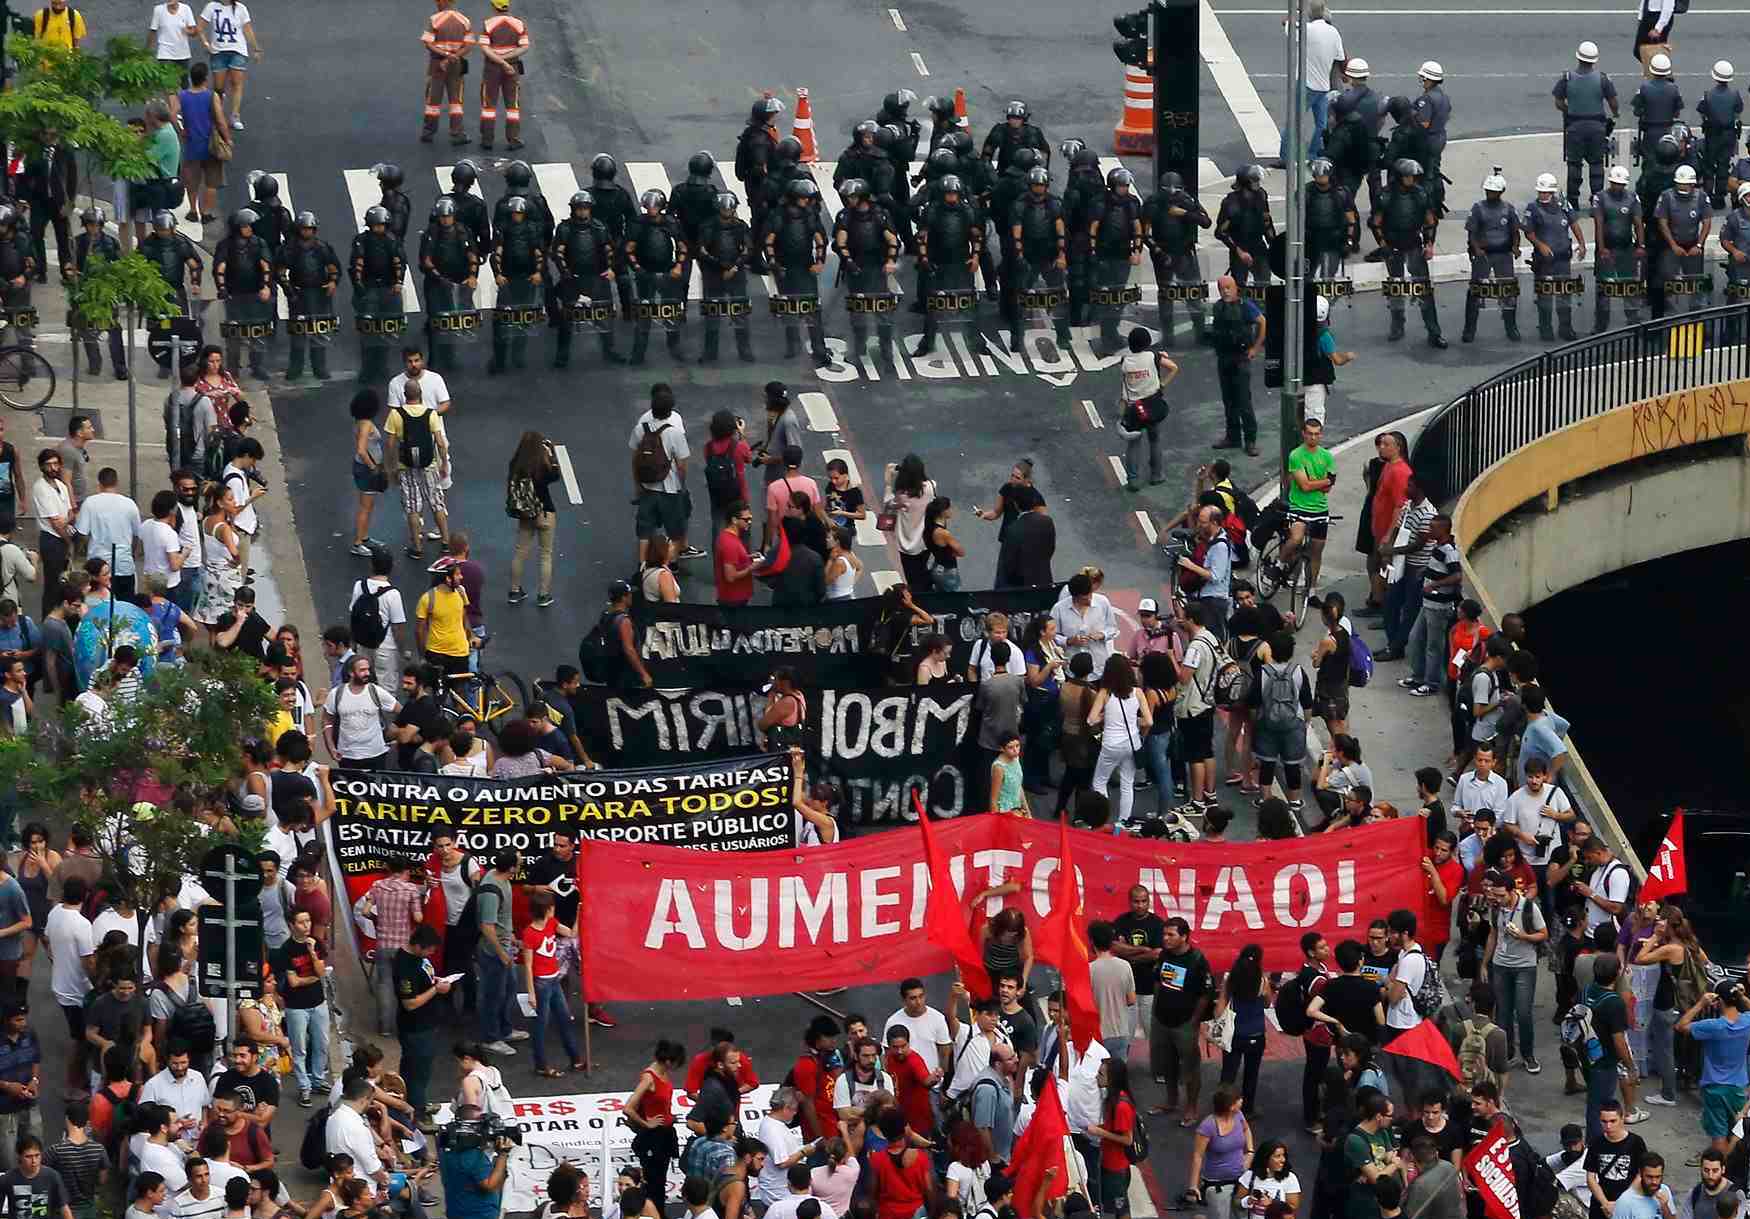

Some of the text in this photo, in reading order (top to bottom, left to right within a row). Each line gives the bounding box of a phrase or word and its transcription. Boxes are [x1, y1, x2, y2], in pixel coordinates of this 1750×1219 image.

[213, 8, 237, 43] LA
[332, 766, 790, 803] CONTRA O AUMENTO DAS TARIFAS!
[335, 785, 788, 826] TARIFA ZERO PARA TODOS!
[338, 823, 488, 850] ESTATIZAÃO
[495, 832, 530, 849] DO
[693, 812, 789, 838] PÚBLICO
[721, 834, 789, 852] USUÁRIOS!
[340, 845, 366, 858] SEM
[512, 1099, 577, 1118] R$
[588, 1117, 604, 1130] O
